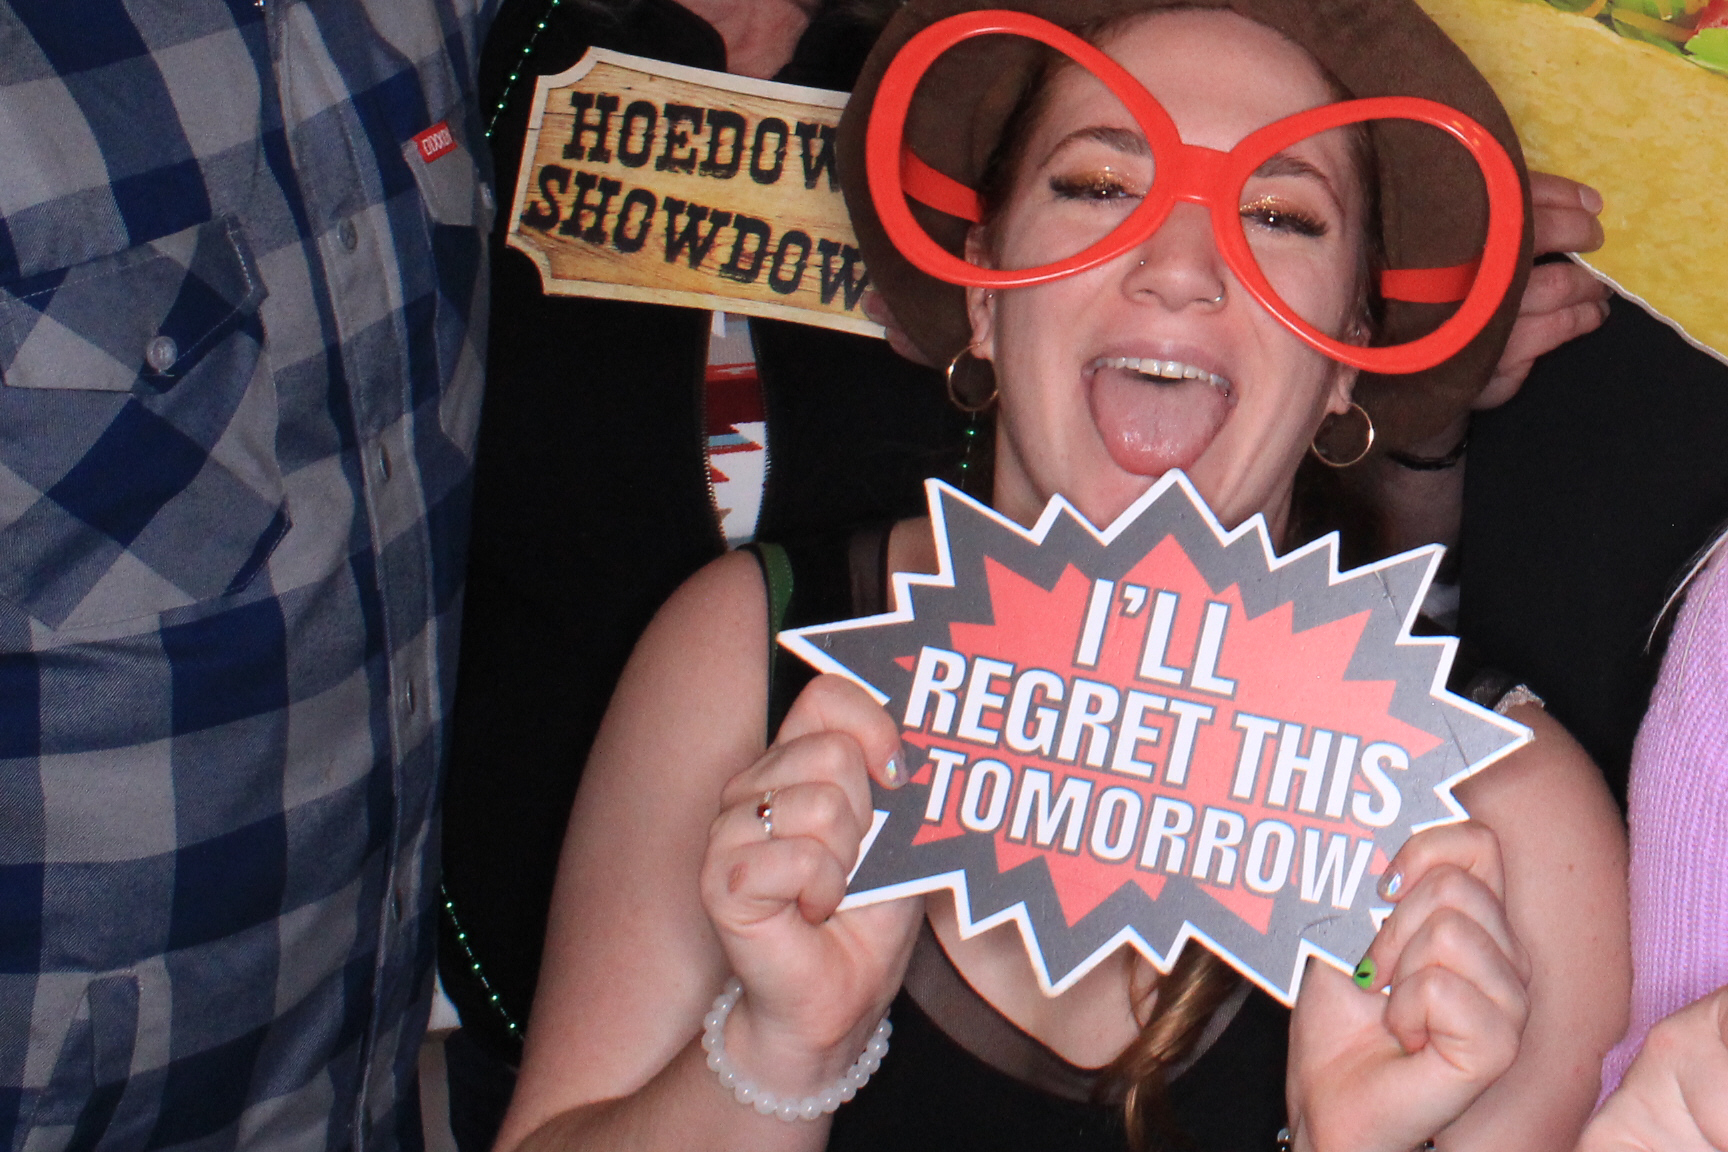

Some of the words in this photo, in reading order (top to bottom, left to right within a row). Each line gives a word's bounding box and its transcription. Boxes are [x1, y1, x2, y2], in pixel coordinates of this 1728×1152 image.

[562, 91, 842, 192] HOEDOW
[520, 164, 869, 312] SHOWDOW
[1072, 579, 1235, 696] I'LL
[903, 645, 1213, 787] REGRET
[1229, 713, 1411, 829] THIS
[924, 748, 1374, 910] TOMORROW
